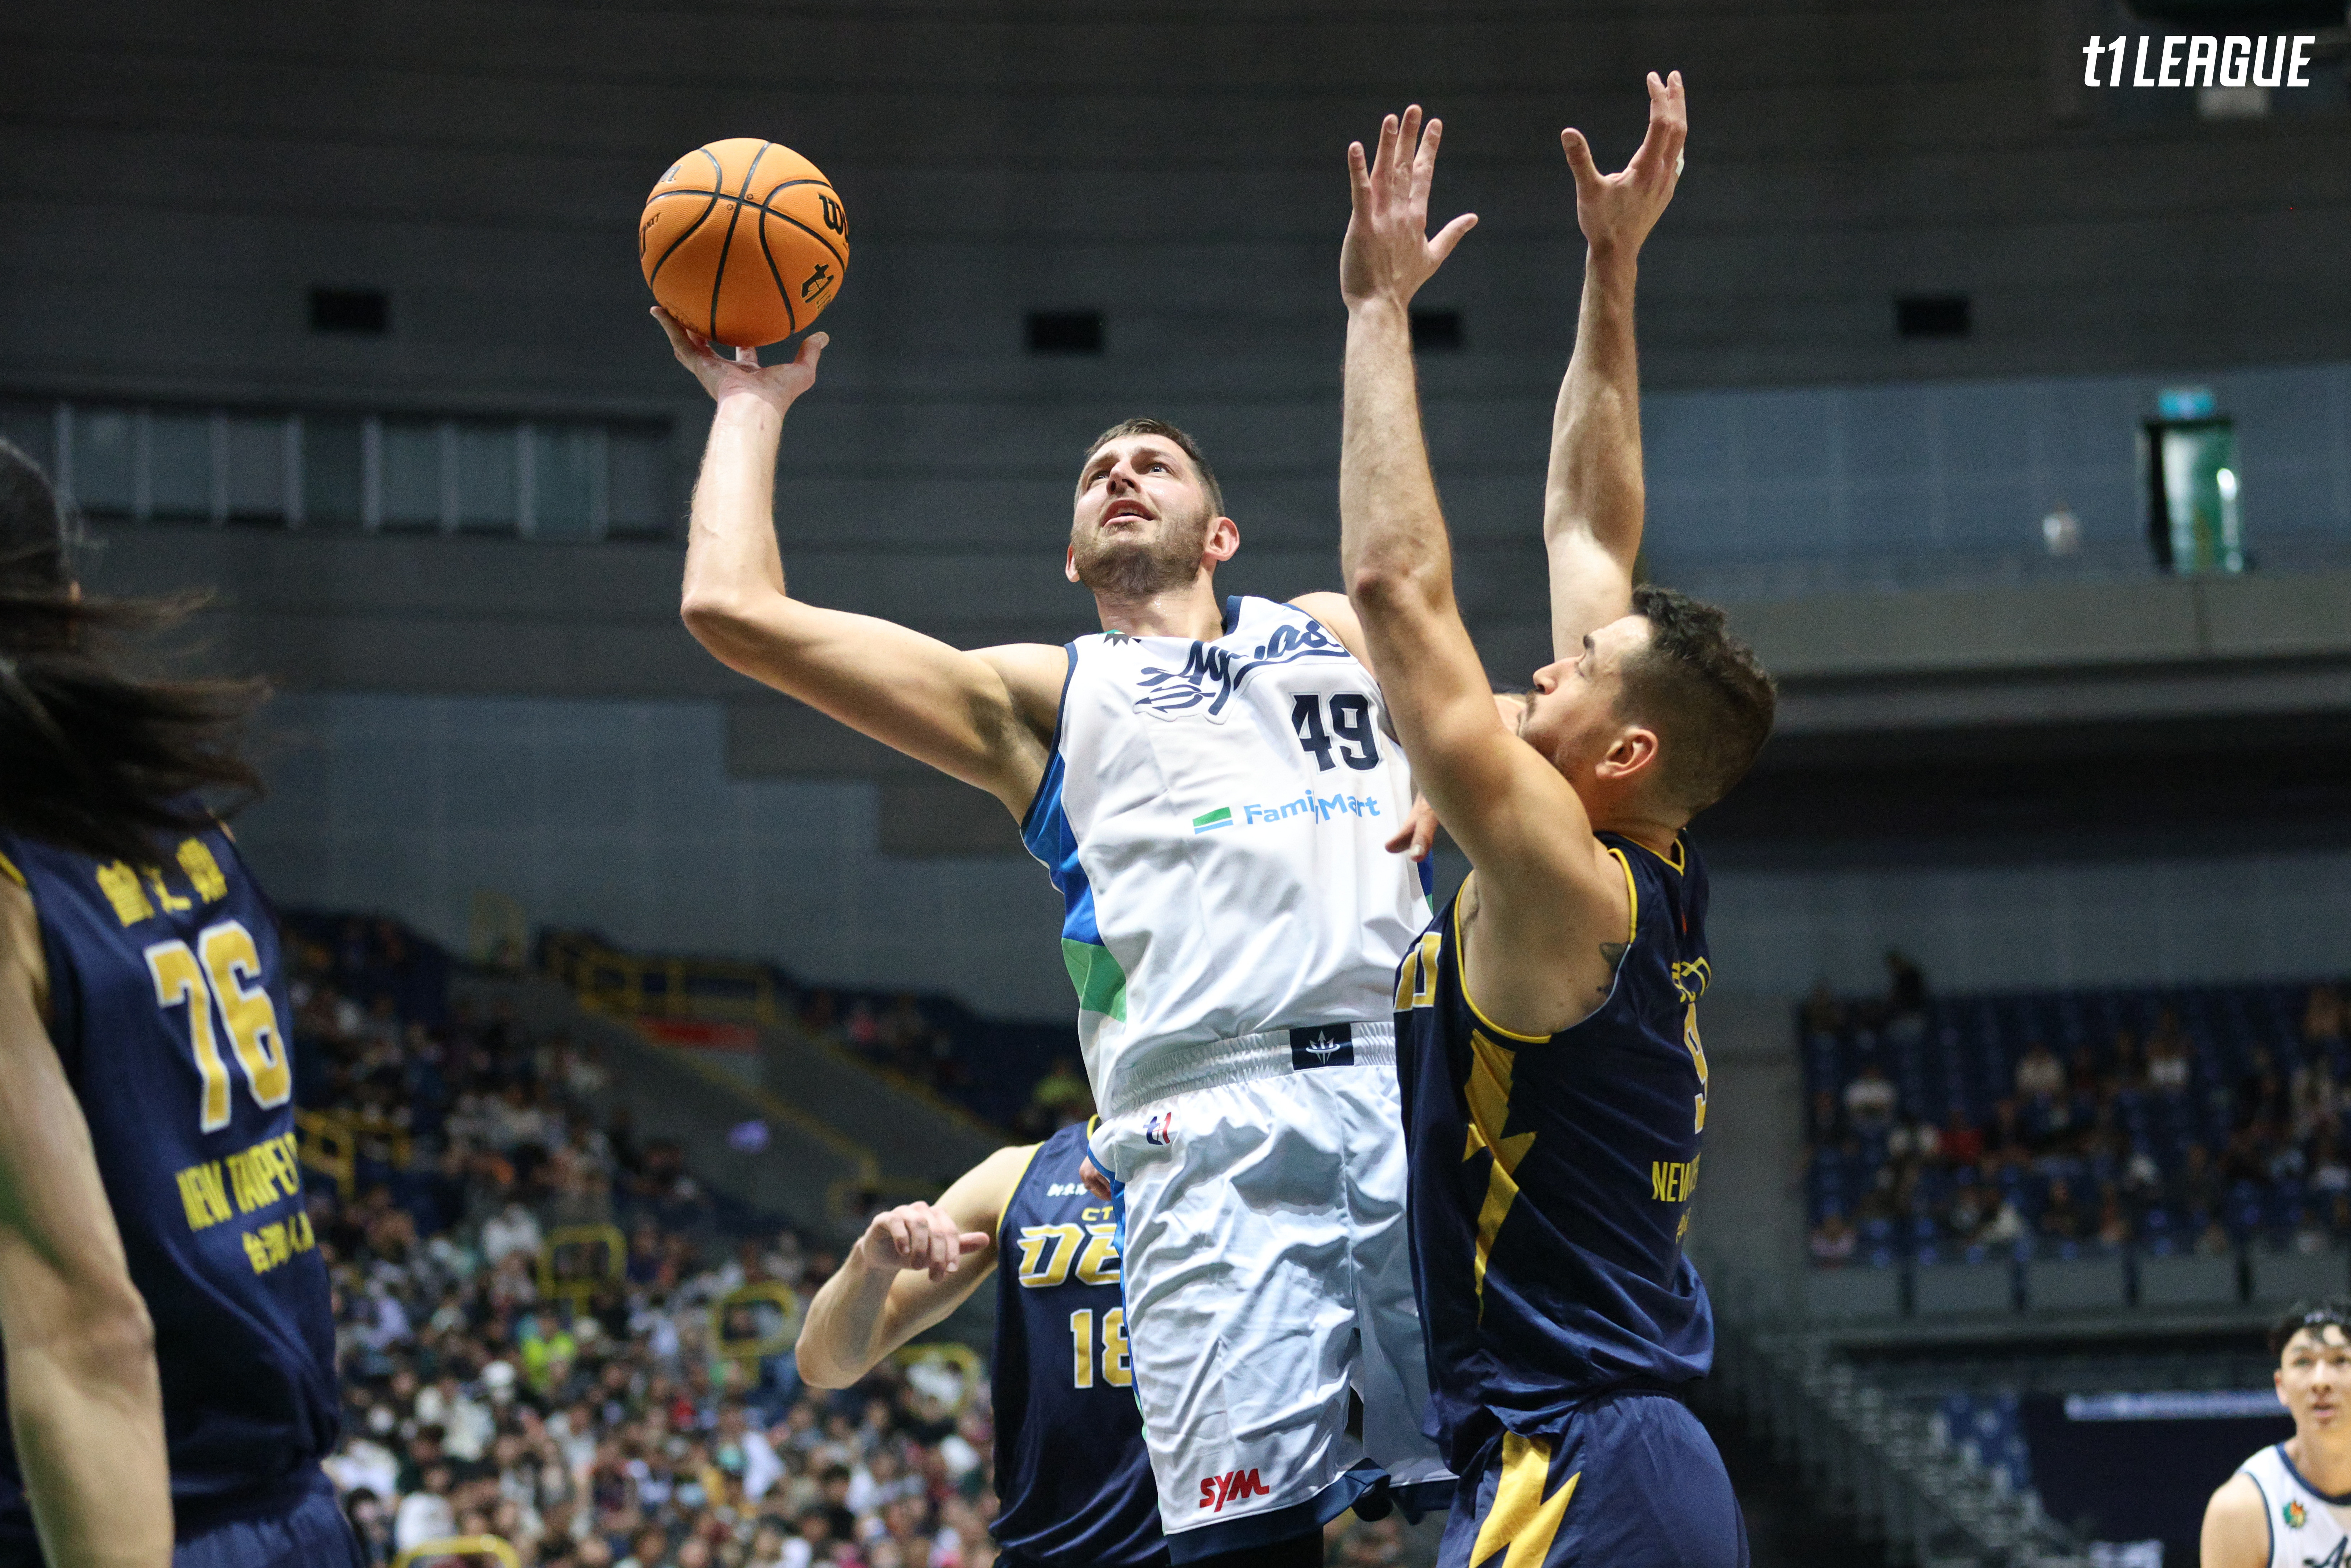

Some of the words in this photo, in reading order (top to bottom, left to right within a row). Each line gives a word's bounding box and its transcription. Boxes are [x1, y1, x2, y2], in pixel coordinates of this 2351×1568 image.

[1290, 692, 1384, 775] 49
[1243, 789, 1381, 825] FamiMart
[144, 919, 292, 1135] 76
[1199, 1468, 1270, 1513] SYM
